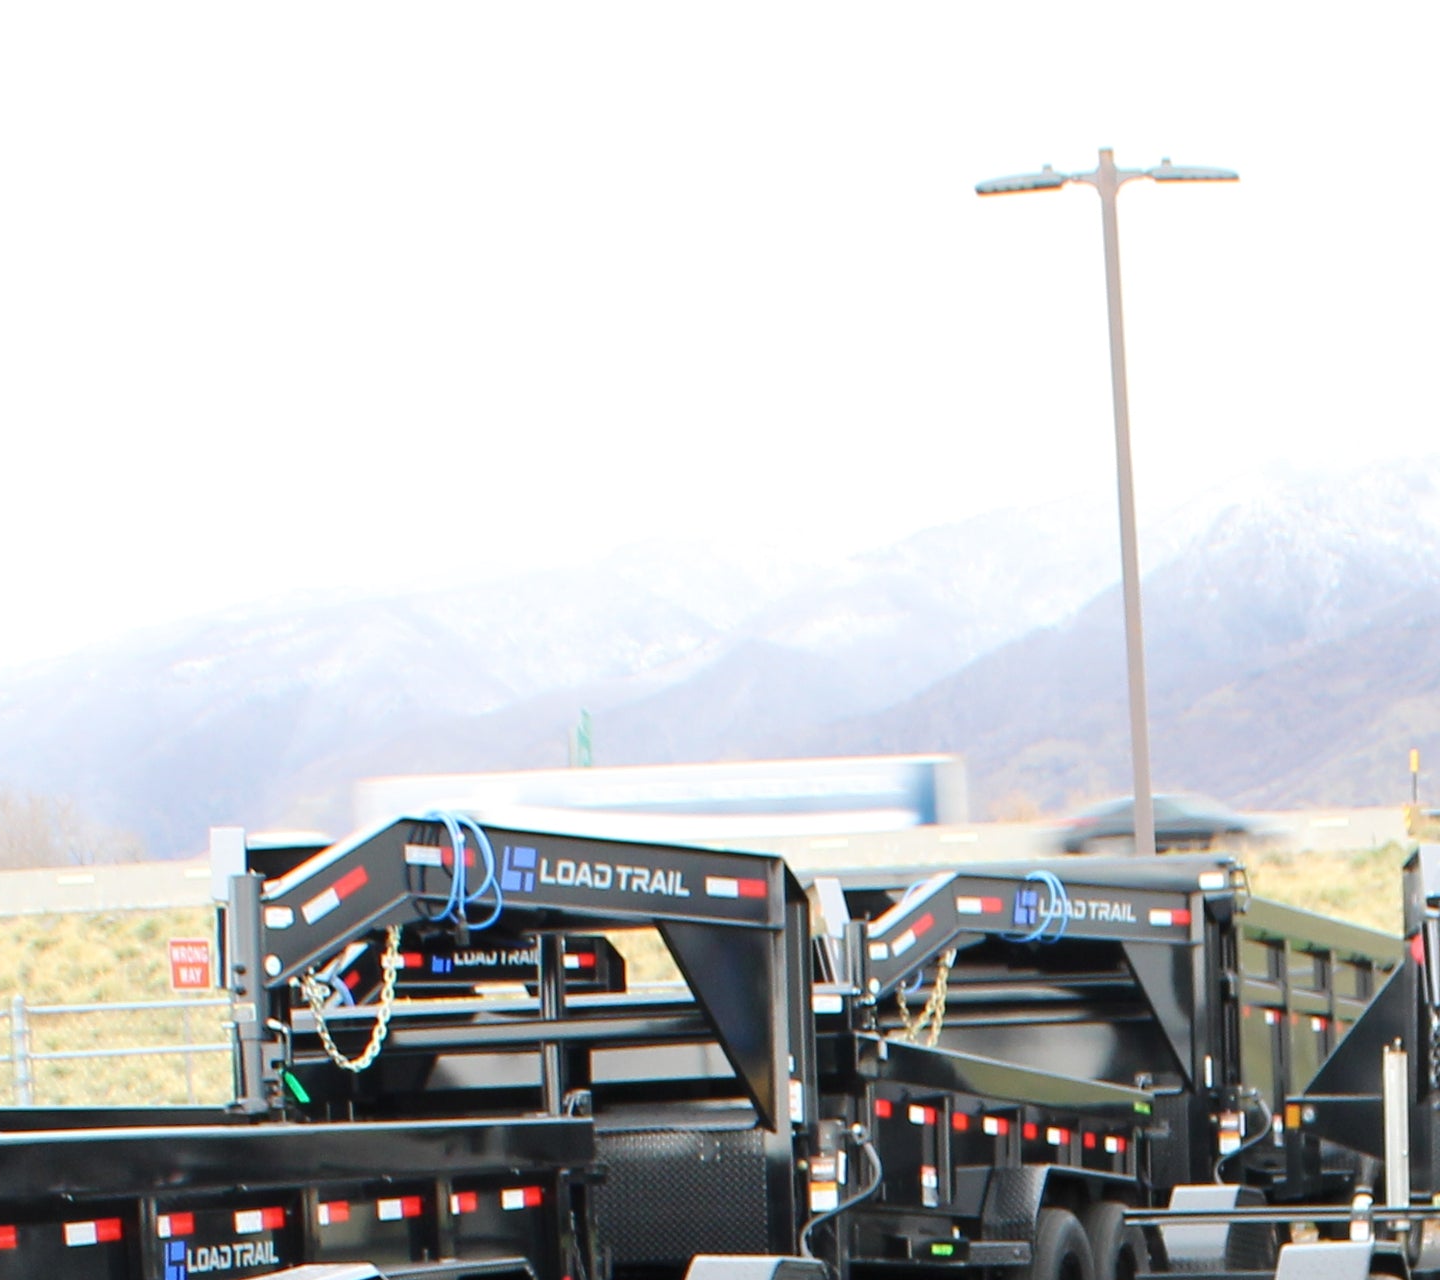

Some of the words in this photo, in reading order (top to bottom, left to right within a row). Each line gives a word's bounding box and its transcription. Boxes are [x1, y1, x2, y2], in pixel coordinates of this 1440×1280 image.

[539, 858, 612, 889] LOAD
[616, 866, 690, 897] TRAIL
[1038, 898, 1086, 920] LOAD
[1087, 900, 1137, 923] TRAIL
[172, 946, 209, 963] WRONG
[180, 967, 203, 984] WAY
[187, 1245, 232, 1273] LOAD
[232, 1240, 279, 1268] TRAIL
